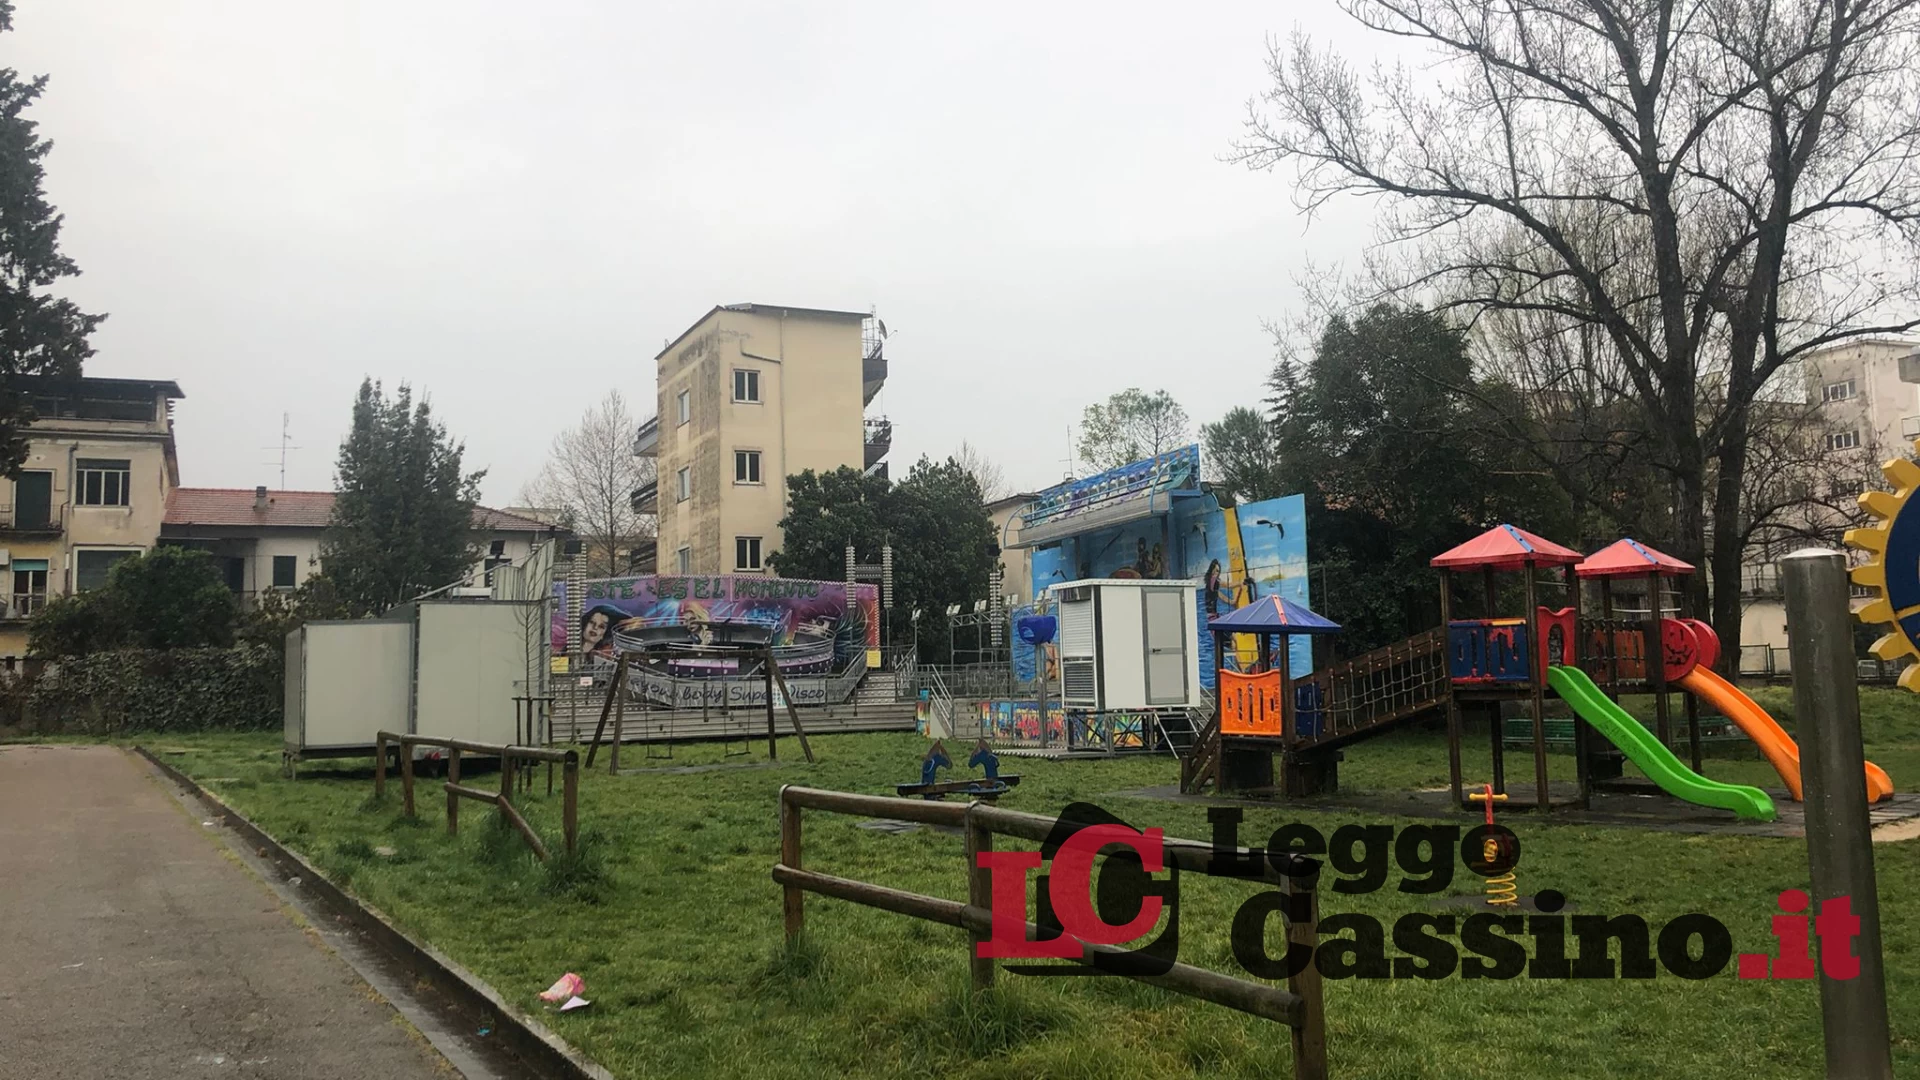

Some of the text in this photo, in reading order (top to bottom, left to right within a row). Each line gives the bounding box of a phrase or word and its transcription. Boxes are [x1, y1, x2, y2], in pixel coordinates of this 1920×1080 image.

[578, 579, 637, 600] STE
[694, 577, 725, 599] EL
[683, 685, 724, 702] body
[730, 686, 774, 703] Supe
